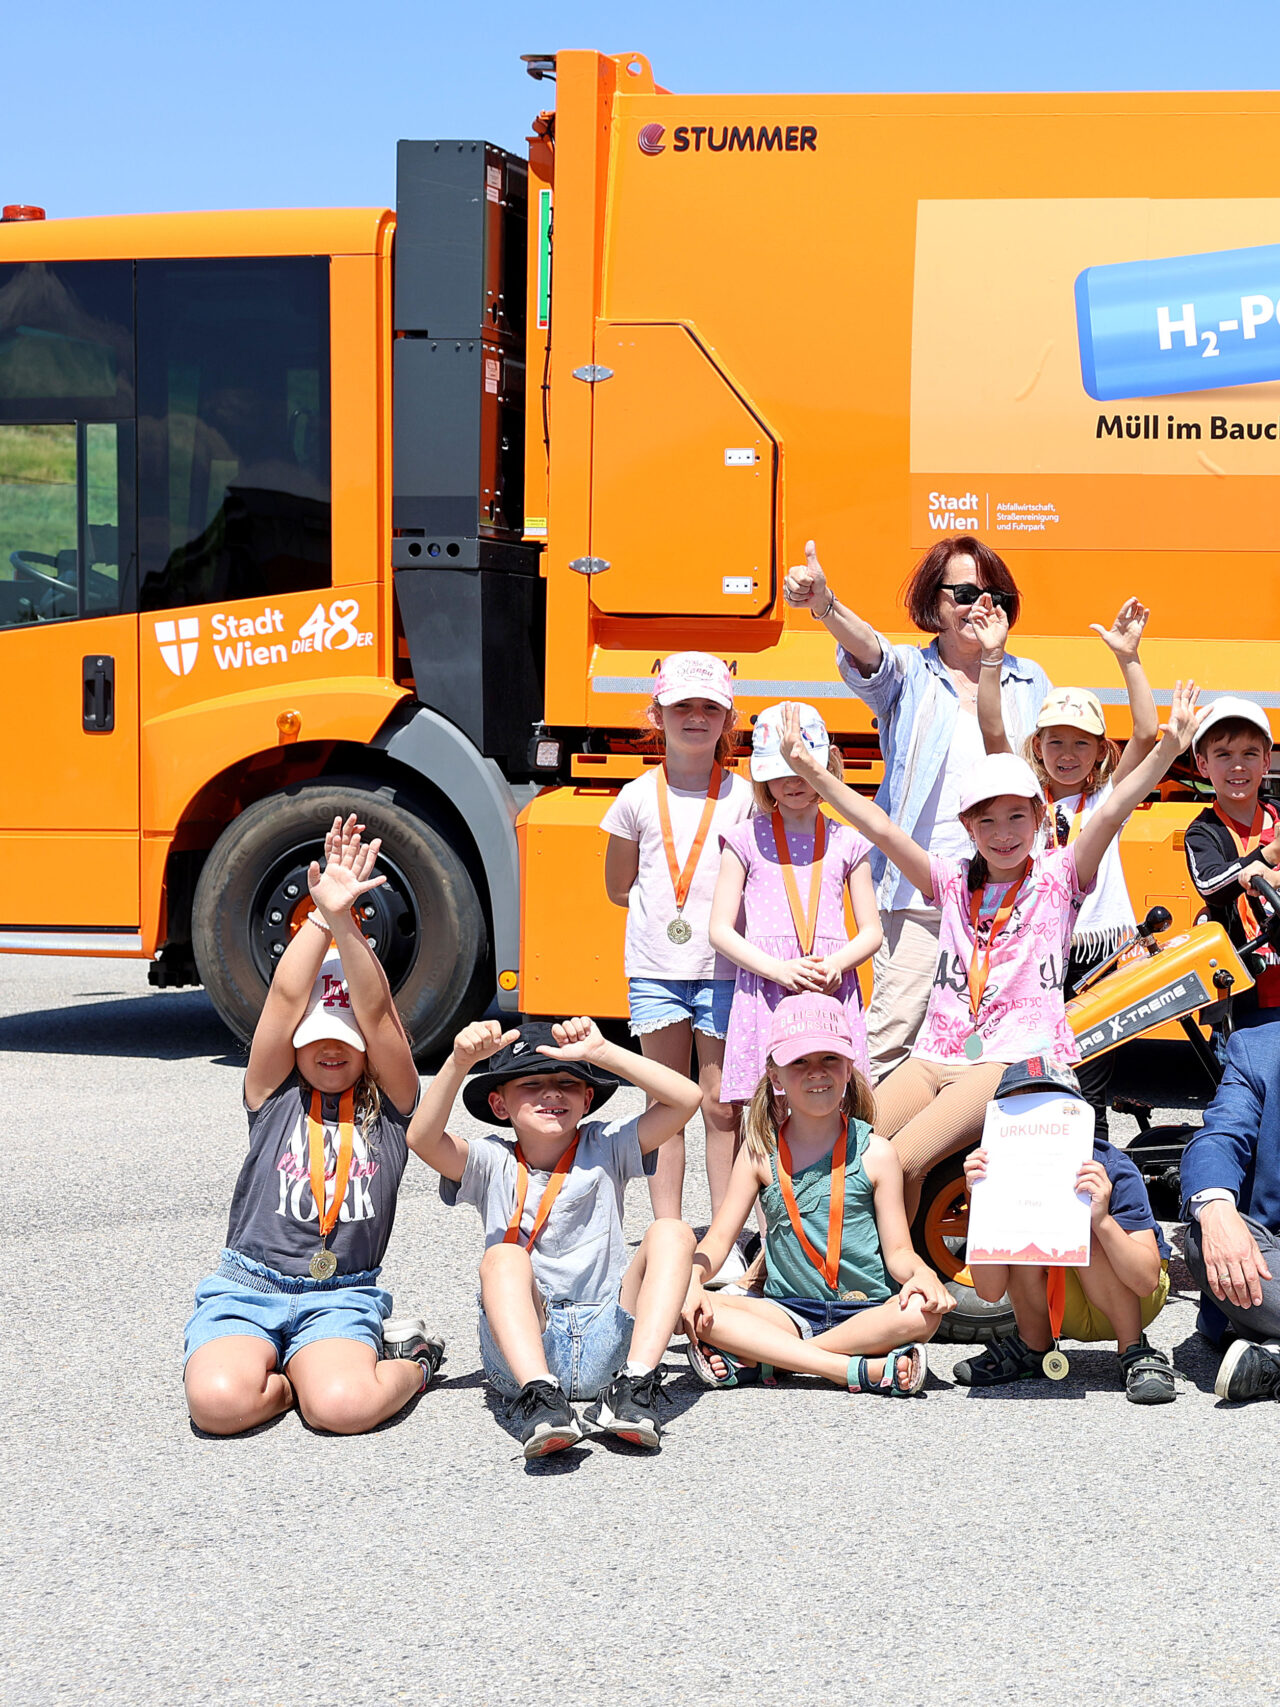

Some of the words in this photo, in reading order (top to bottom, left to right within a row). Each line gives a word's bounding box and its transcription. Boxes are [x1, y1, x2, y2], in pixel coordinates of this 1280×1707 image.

[673, 126, 818, 152] STUMMER
[1096, 415, 1159, 440] Müll
[1167, 415, 1201, 440] im
[928, 491, 979, 511] Stadt
[996, 503, 1056, 512] Abfallwirtschaft,
[928, 512, 979, 530] Wien
[996, 512, 1060, 523] Straßenreinigung
[996, 523, 1011, 531] und
[1012, 523, 1046, 532] Fuhrpark
[211, 607, 285, 641] Stadt
[212, 641, 288, 671] Wien
[320, 974, 351, 1008] LA
[1075, 1030, 1105, 1053] ERG
[1108, 984, 1187, 1041] X-TREME
[1000, 1123, 1071, 1138] URKUNDE
